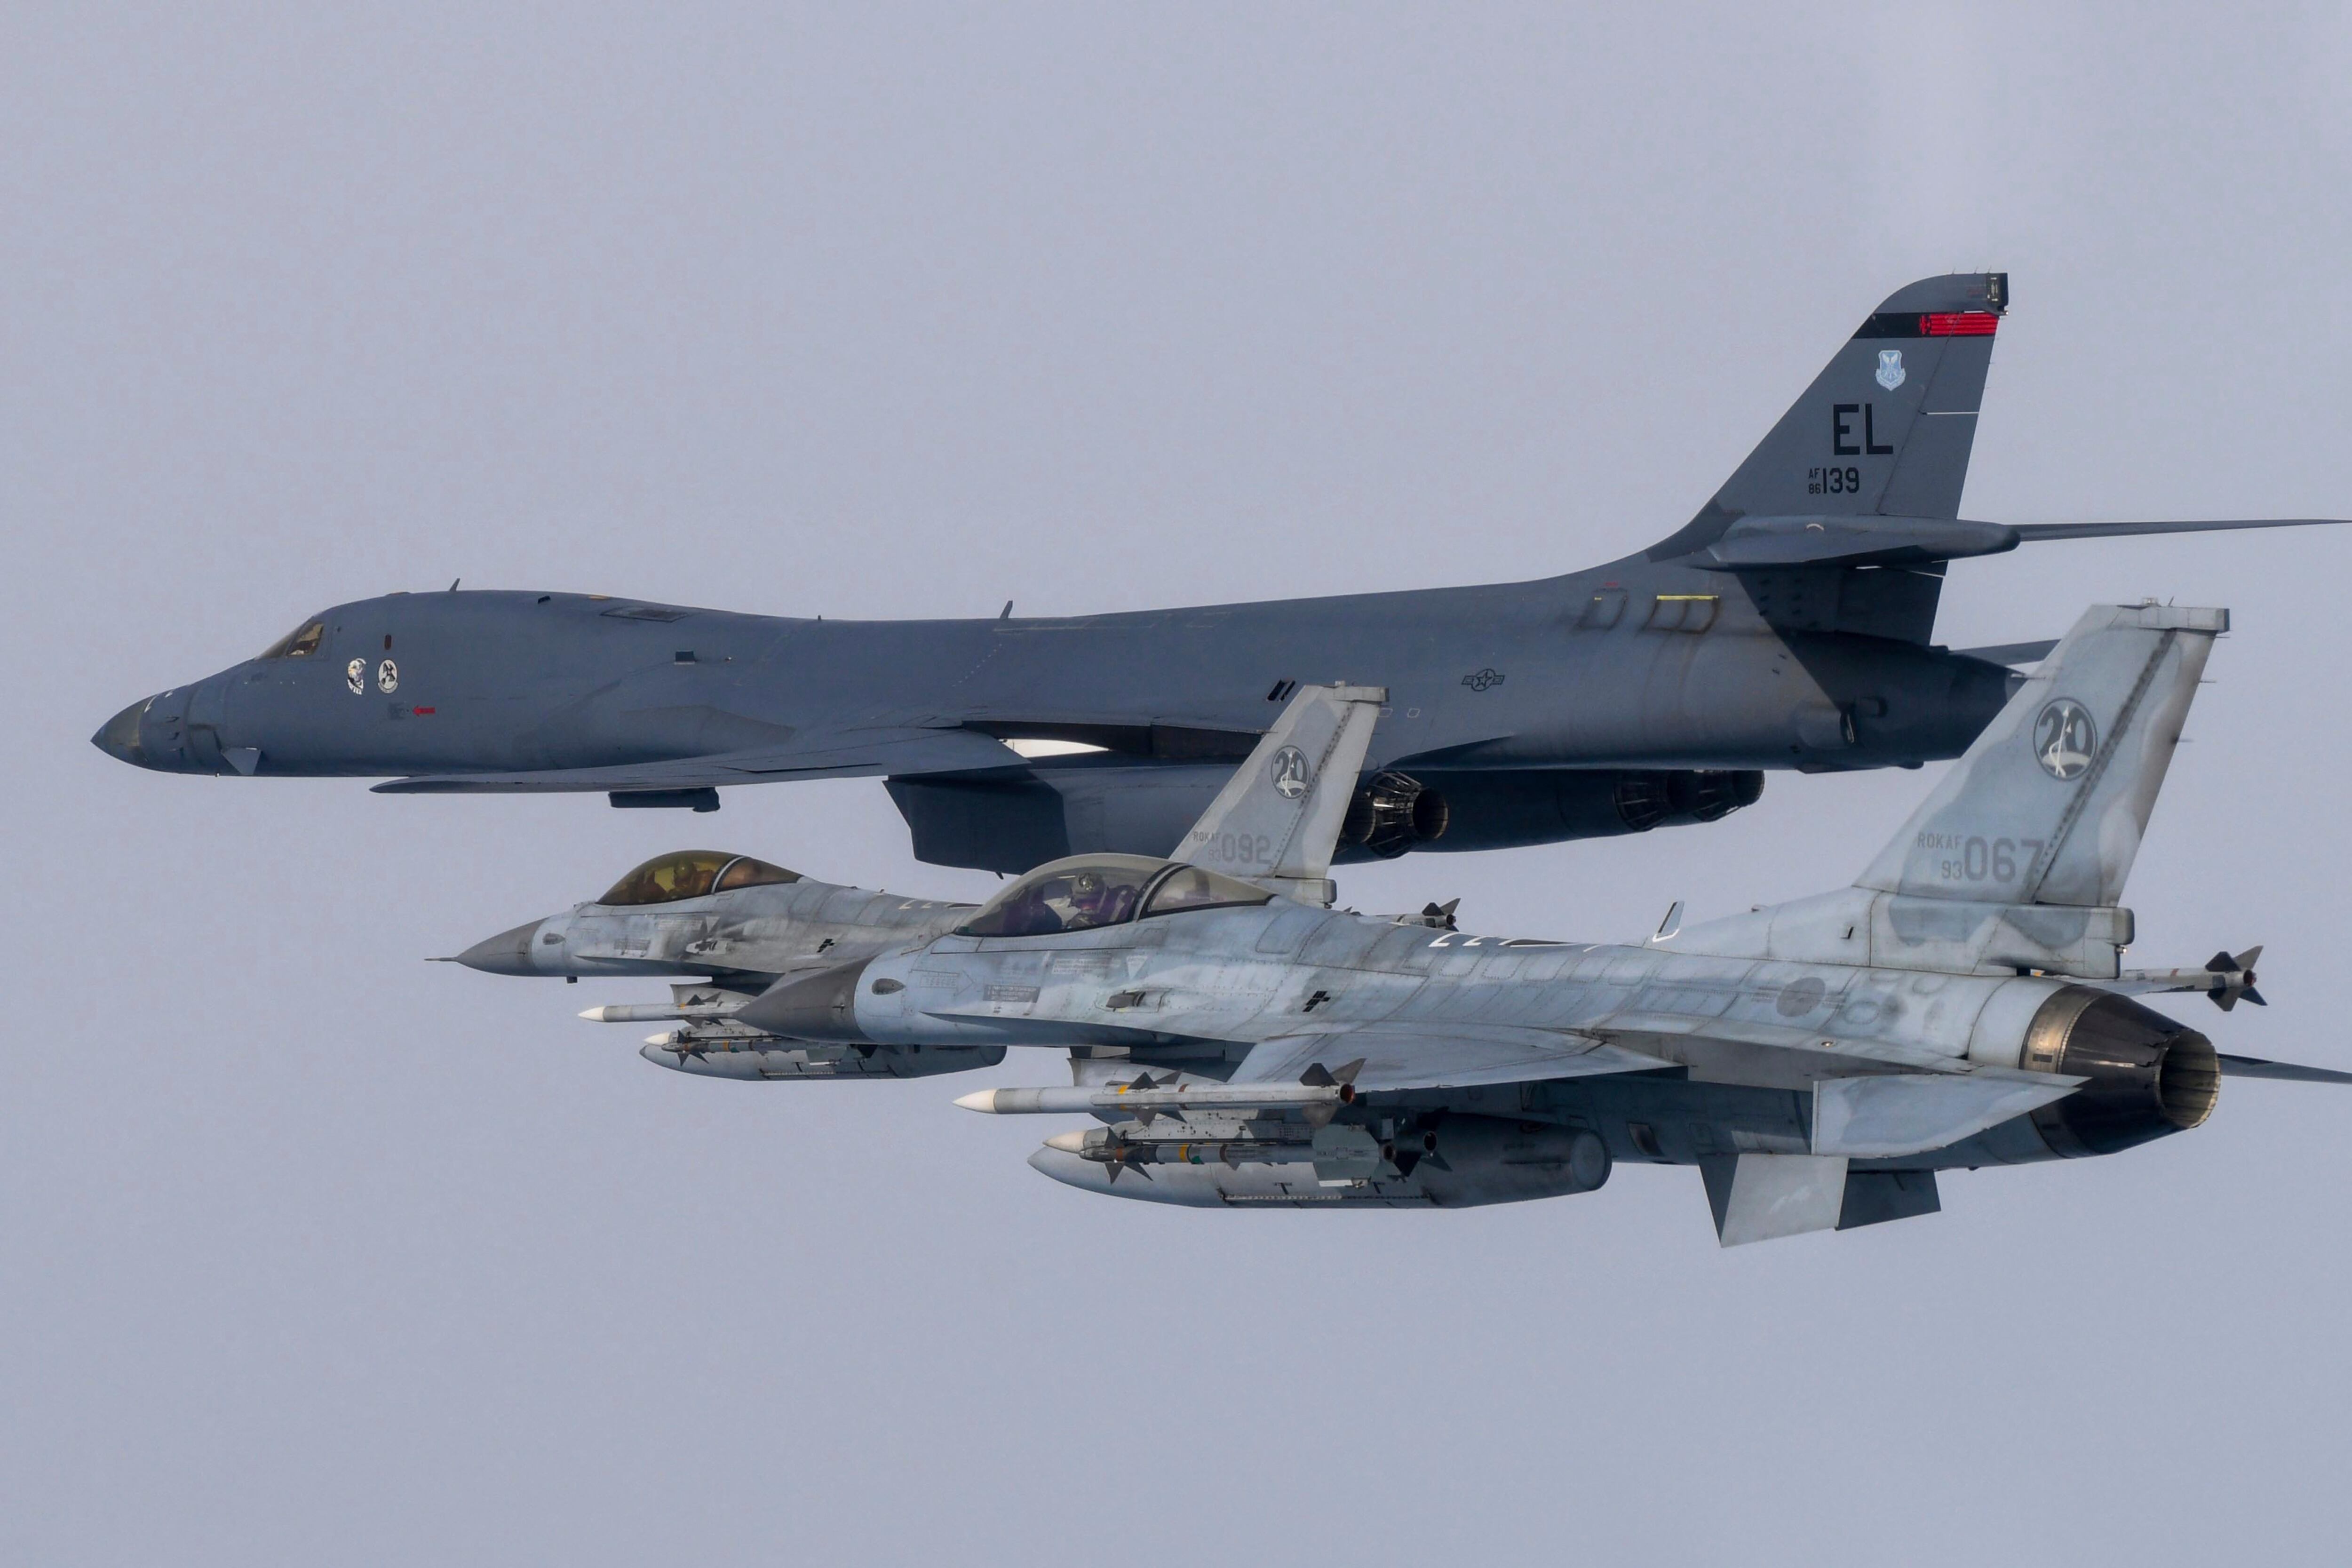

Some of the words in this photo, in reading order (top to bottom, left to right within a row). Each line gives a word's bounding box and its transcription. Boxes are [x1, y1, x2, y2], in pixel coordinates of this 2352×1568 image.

[1833, 403, 1893, 455] EL
[1808, 468, 1820, 478] AF
[1808, 483, 1821, 494] 86
[1823, 467, 1859, 494] 139
[2038, 706, 2094, 758] 20
[1274, 751, 1308, 785] 20
[1222, 833, 1271, 865] 092
[1964, 835, 2045, 888] 067
[1941, 860, 1963, 880] 93
